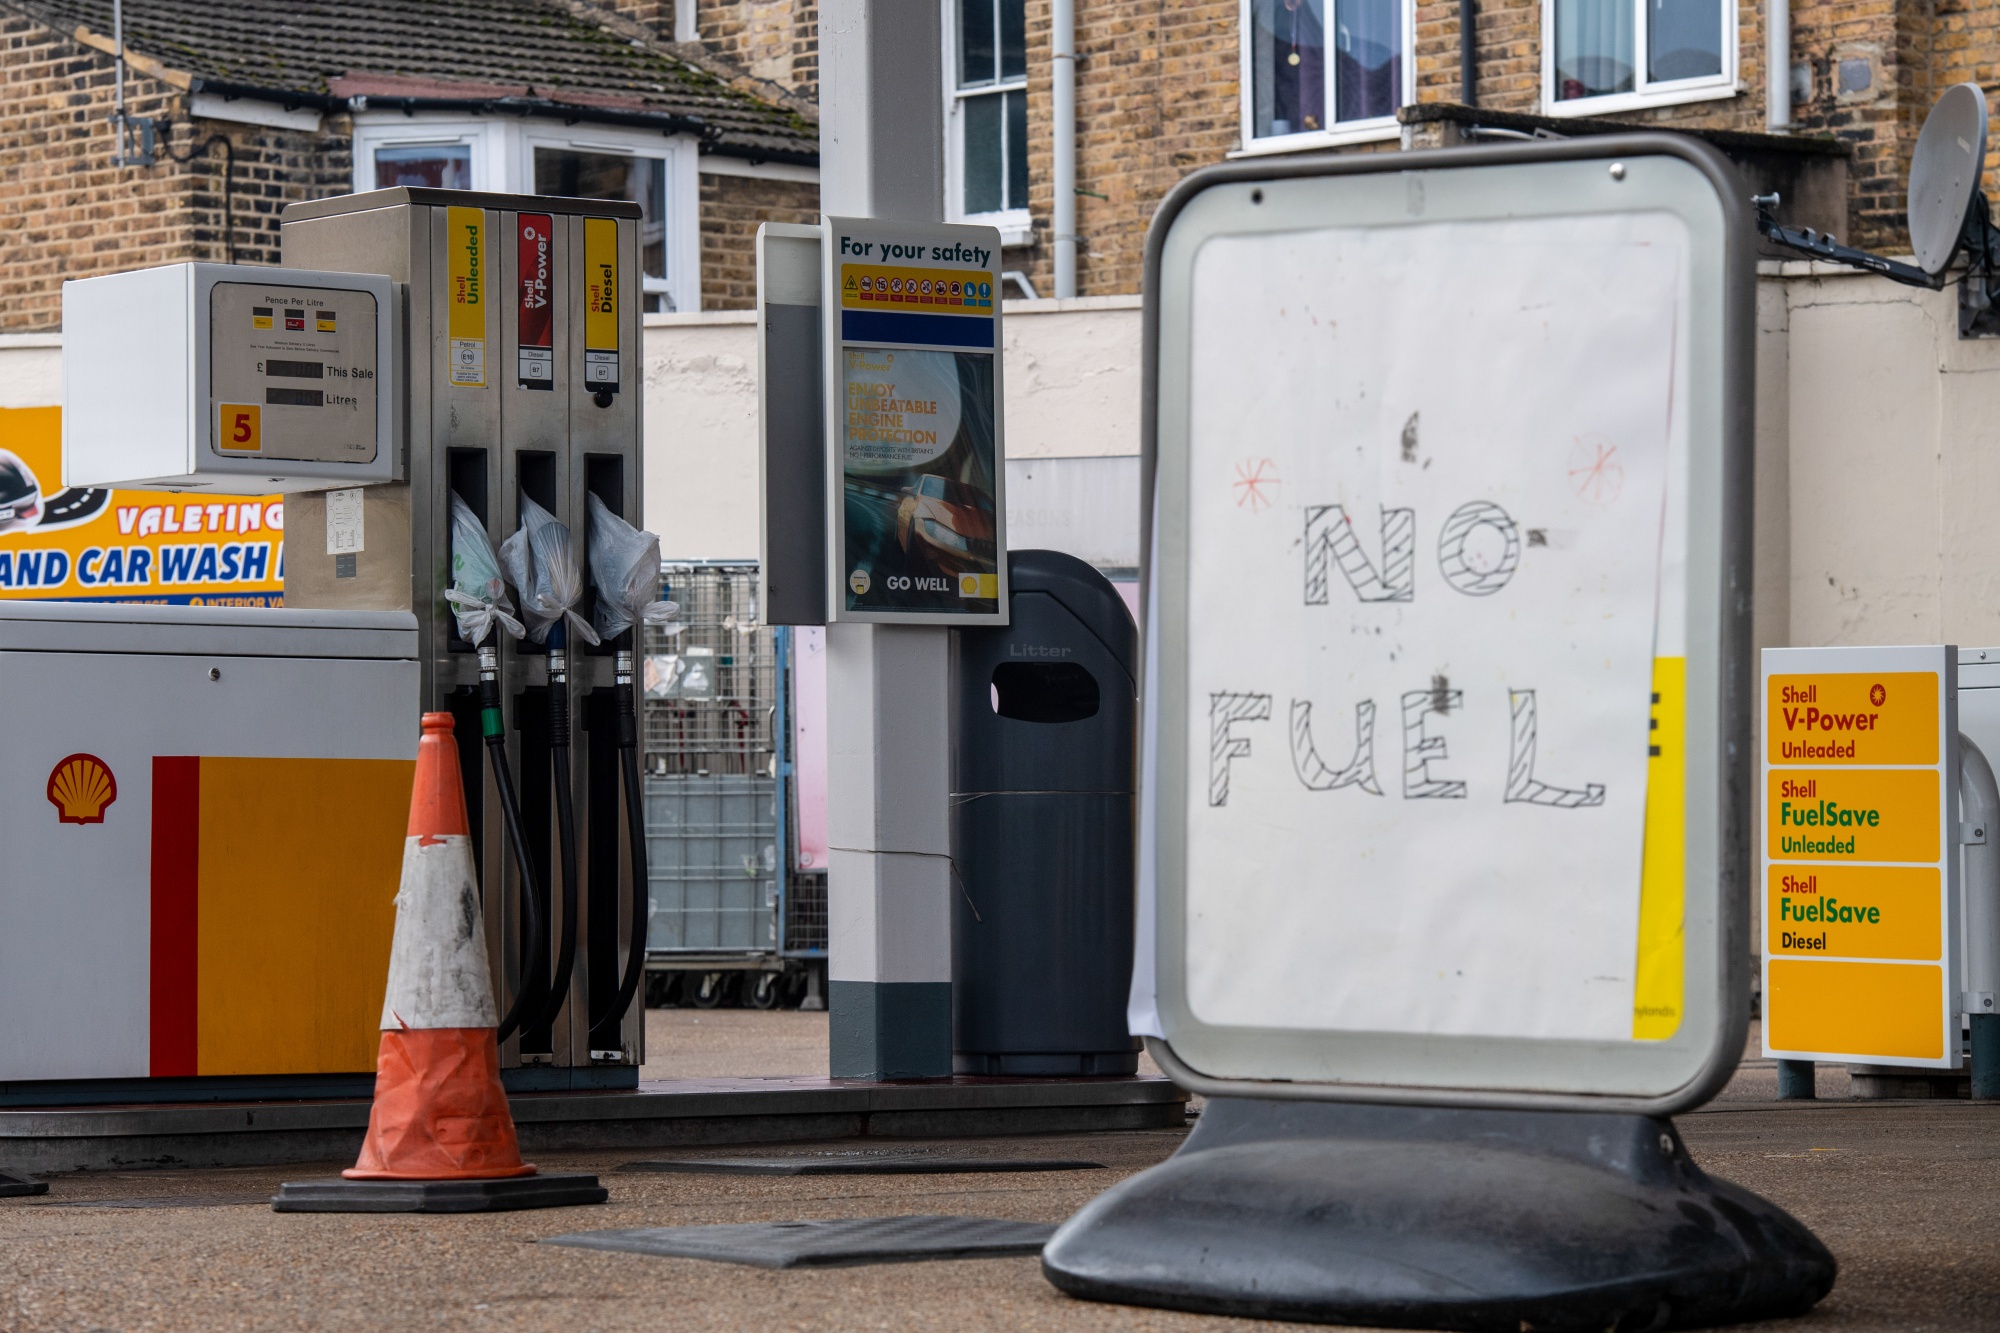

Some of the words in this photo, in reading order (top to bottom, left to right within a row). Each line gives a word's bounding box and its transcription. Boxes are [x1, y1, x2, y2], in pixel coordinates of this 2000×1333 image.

[840, 236, 873, 257] For
[880, 243, 926, 262] your
[931, 242, 991, 269] safety
[465, 225, 479, 305] Unleaded
[534, 233, 547, 309] V-Power
[457, 276, 466, 304] Shell
[524, 279, 534, 309] Shell
[590, 284, 600, 312] Shell
[599, 264, 613, 313] Diesel
[265, 295, 289, 305] Pence
[291, 297, 304, 306] Per
[306, 298, 324, 307] Litre
[257, 362, 263, 372] £
[327, 366, 348, 378] This
[351, 367, 374, 379] Sale
[850, 360, 892, 372] V-Power
[326, 394, 357, 405] Litres
[848, 382, 896, 397] ENJOY
[848, 397, 937, 414] UNBEATABLE
[233, 413, 252, 443] 5
[848, 411, 904, 428] ENGINE
[849, 427, 937, 444] PROTECTION
[117, 503, 283, 538] VALETING
[1304, 500, 1521, 605] NO
[0, 551, 68, 587] AND
[78, 546, 151, 584] CAR
[161, 544, 268, 582] WASH
[887, 576, 911, 590] GO
[915, 577, 950, 592] WELL
[1010, 643, 1072, 657] Litter
[1781, 685, 1817, 703] Shell
[1782, 707, 1879, 731] V-Power
[1209, 688, 1605, 808] FUEL
[1781, 740, 1856, 759] Unleaded
[1781, 780, 1817, 798] Shell
[1781, 801, 1880, 827] FuelSave
[1781, 836, 1855, 854] Unleaded
[1781, 875, 1817, 894] Shell
[1781, 896, 1881, 924] FuelSave
[1781, 931, 1827, 951] Diesel
